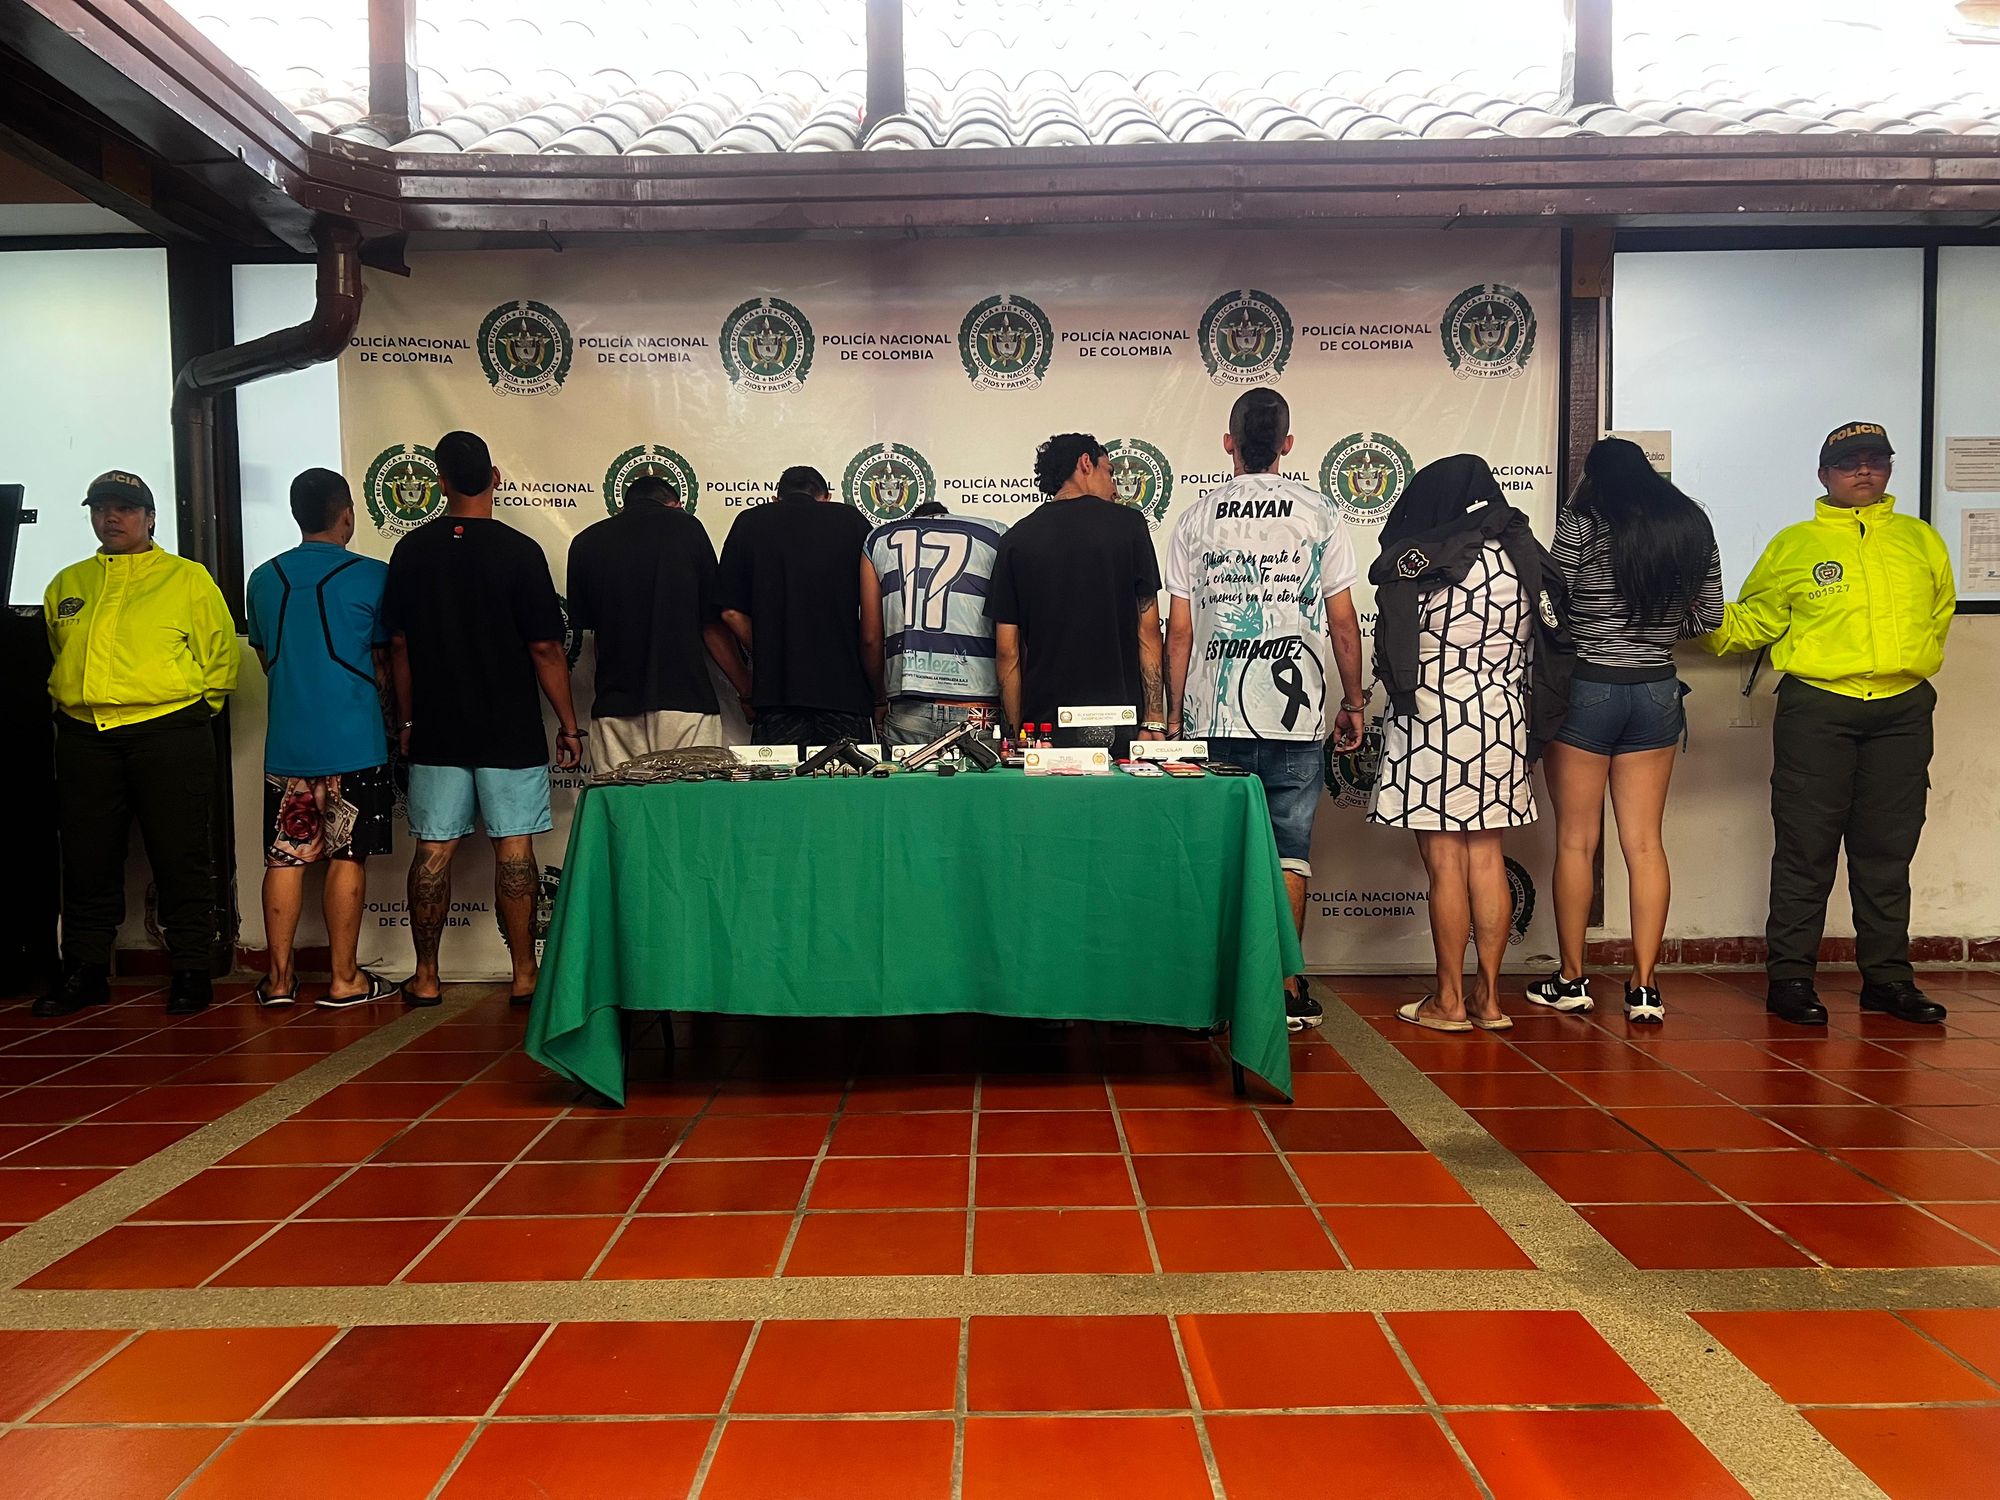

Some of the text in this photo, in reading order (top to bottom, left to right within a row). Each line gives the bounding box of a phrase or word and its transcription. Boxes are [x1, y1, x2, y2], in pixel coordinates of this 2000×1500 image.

[1211, 304, 1234, 343] REPUBLICA
[1260, 304, 1281, 342] COLOMBIA
[1453, 299, 1477, 337] REPUBLICA
[1504, 299, 1525, 336] COLOMBIA
[490, 315, 511, 353] REPUBLICA
[537, 315, 561, 352] COLOMBIA
[732, 313, 754, 351] REPUBLICA
[780, 313, 803, 351] COLOMBIA
[971, 310, 994, 348] REPUBLICA
[1020, 310, 1042, 347] COLOMBIA
[1062, 329, 1190, 341] POLICÍA NACIONAL
[1302, 323, 1432, 336] POLICÍA NACIONAL
[350, 335, 470, 349] OLICÍA NACIONAL
[580, 336, 708, 348] POLICÍA NACIONAL
[823, 333, 952, 345] POLICÍA NACIONAL
[1321, 340, 1413, 350] DE COLOMBIA
[598, 353, 691, 362] DE COLOMBIA
[841, 350, 933, 360] DE COLOMBIA
[1080, 346, 1172, 356] DE COLOMBIA
[1457, 345, 1521, 367] POLICIA NACIONAL
[361, 353, 453, 364] DE COLOMBIA
[1215, 351, 1278, 373] POLICIA NACIONAL
[494, 362, 558, 384] POLICIA NACIONAL
[736, 360, 799, 381] POLICIA NACIONAL
[975, 356, 1038, 378] POLICIA NACIONAL
[1490, 366, 1513, 376] PATRIA
[1007, 377, 1031, 388] PATRIA
[1246, 372, 1270, 382] PATRIA
[528, 383, 551, 393] PATRIA
[769, 381, 792, 391] PATRIA
[1829, 424, 1885, 446] POLICIA
[1140, 453, 1161, 489] COLOMBIA
[1332, 447, 1355, 485] REPUBLICA
[1381, 447, 1403, 483] COLOMBIA
[1492, 465, 1552, 476] ACIONAL
[95, 473, 141, 488] LICIA
[376, 459, 397, 497] REPUBLICA
[616, 460, 638, 497] REPUBLICA
[664, 460, 687, 496] COLOMBIA
[854, 458, 876, 495] REPUBLICA
[902, 458, 924, 494] COLOMBIA
[944, 476, 1040, 488] POLICÍA NACIO
[1181, 471, 1232, 484] POLICÍA
[522, 483, 594, 492] NACIONAL
[707, 480, 760, 491] POLICÍA
[1502, 481, 1533, 490] MBIA
[494, 497, 577, 507] E COLOMBIA
[725, 497, 742, 506] DE
[962, 493, 1052, 503] DE COLOMBIA
[1144, 496, 1159, 514] ONAL
[1335, 493, 1400, 515] POLICIA NACIONAL
[381, 503, 444, 526] POLICIA NACIONAL
[858, 504, 881, 524] POLICIA
[1216, 500, 1293, 519] BRAYAN
[1236, 554, 1256, 566] eres
[1260, 550, 1288, 568] parte
[888, 527, 972, 632] 17
[1260, 567, 1270, 584] Te
[1246, 594, 1259, 602] en
[1263, 589, 1272, 602] la
[1809, 584, 1850, 599] 001927
[903, 647, 960, 674] ortaleza
[553, 780, 585, 788] MBIA
[1337, 776, 1360, 795] POLICIA
[1506, 870, 1523, 903] OLOMBIA
[1306, 890, 1357, 902] POLICÍA
[451, 903, 488, 912] ONAL
[1322, 907, 1415, 916] DE COLOMBIA
[379, 918, 396, 926] DE
